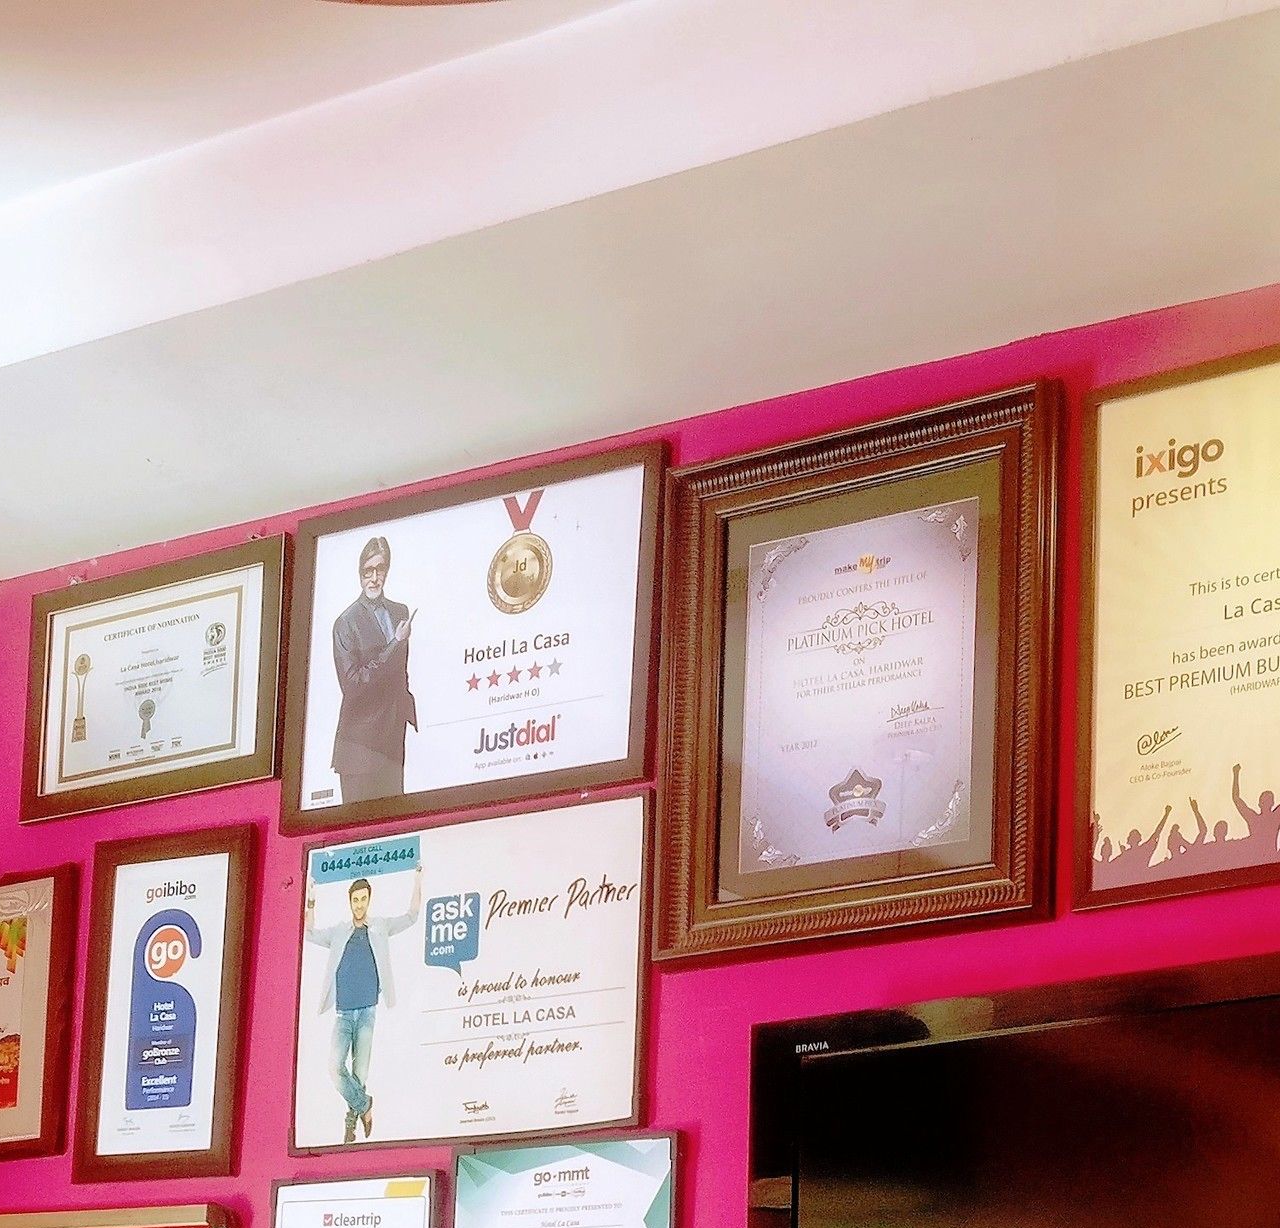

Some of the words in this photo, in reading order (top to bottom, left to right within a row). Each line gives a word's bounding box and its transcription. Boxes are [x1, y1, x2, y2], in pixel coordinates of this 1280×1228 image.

[1135, 436, 1224, 479] ixigo
[1131, 475, 1228, 517] presents
[1222, 602, 1245, 621] La
[787, 627, 853, 651] PLATINUM
[857, 620, 888, 636] PICK
[891, 611, 935, 631] HOTEL
[464, 640, 506, 664] Hotel
[512, 639, 528, 654] La
[533, 632, 569, 650] Casa
[1123, 678, 1165, 700] BEST
[1168, 662, 1252, 693] PREMIUM
[321, 847, 415, 872] 0444-444-4444
[146, 882, 196, 904] goibibo
[485, 889, 558, 929] Premier
[564, 874, 637, 918] Partner
[431, 894, 473, 920] ask
[431, 921, 468, 942] me
[152, 941, 183, 969] go
[462, 1014, 509, 1029] HOTEL
[513, 1011, 531, 1023] LA
[536, 1006, 576, 1021] CASA
[795, 1041, 829, 1054] BRAVIA
[334, 1213, 381, 1227] cleartrip
